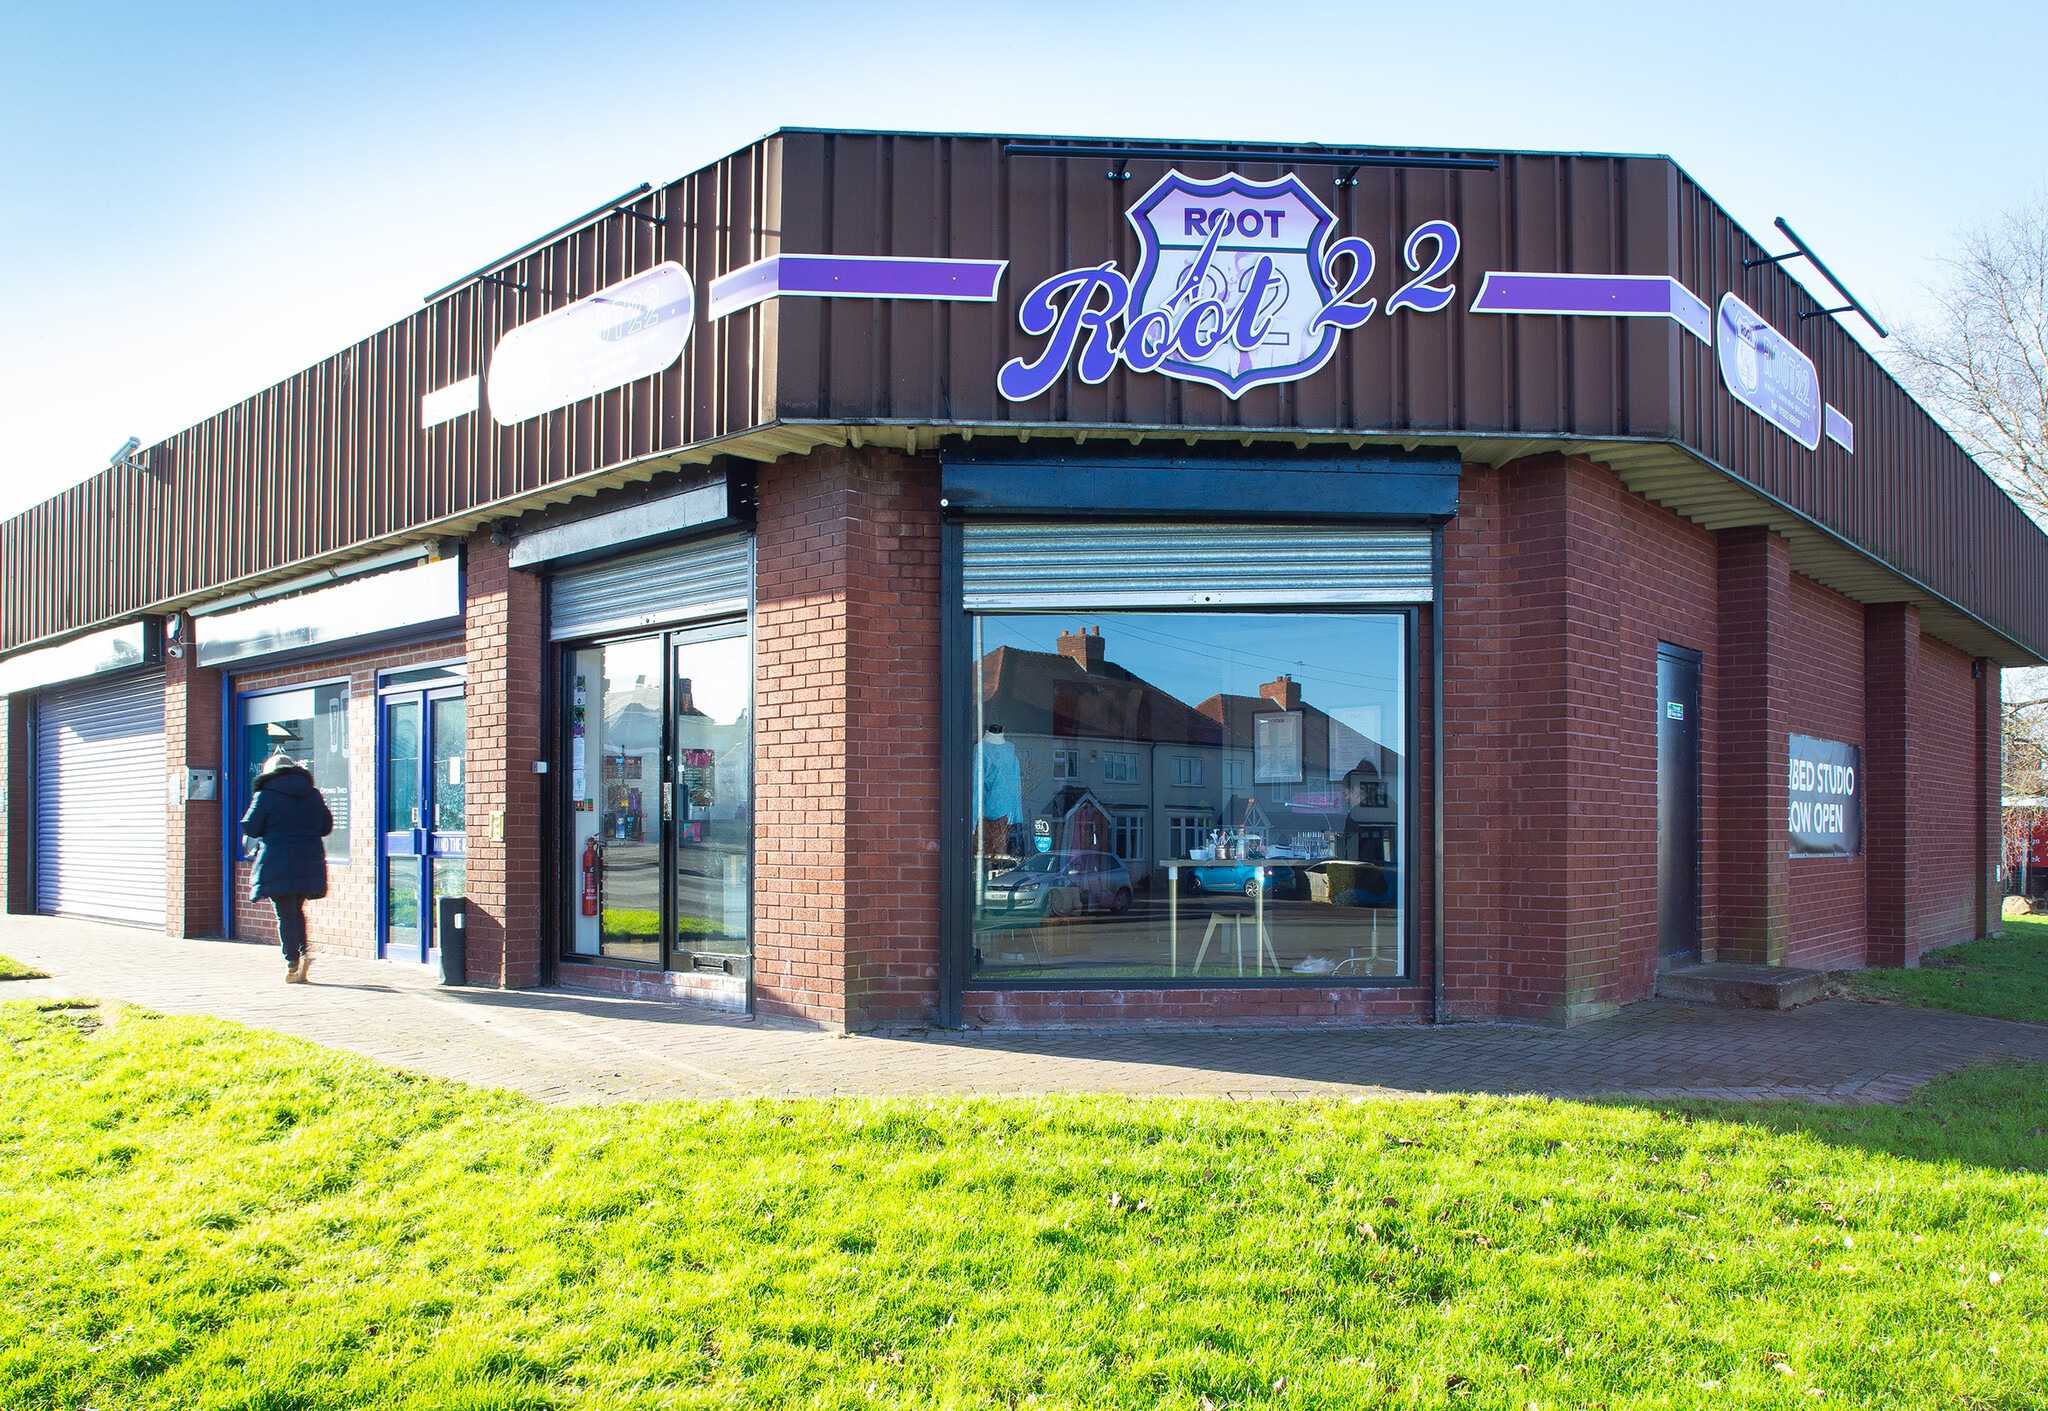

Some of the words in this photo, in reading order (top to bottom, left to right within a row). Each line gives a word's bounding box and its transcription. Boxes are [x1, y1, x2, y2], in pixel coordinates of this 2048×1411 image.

[1185, 208, 1285, 238] ROOT
[997, 256, 1282, 402] Root
[1309, 219, 1461, 336] 22
[1817, 762, 1855, 796] STUDIO
[1813, 802, 1844, 833] OPEN
[449, 838, 462, 852] THE
